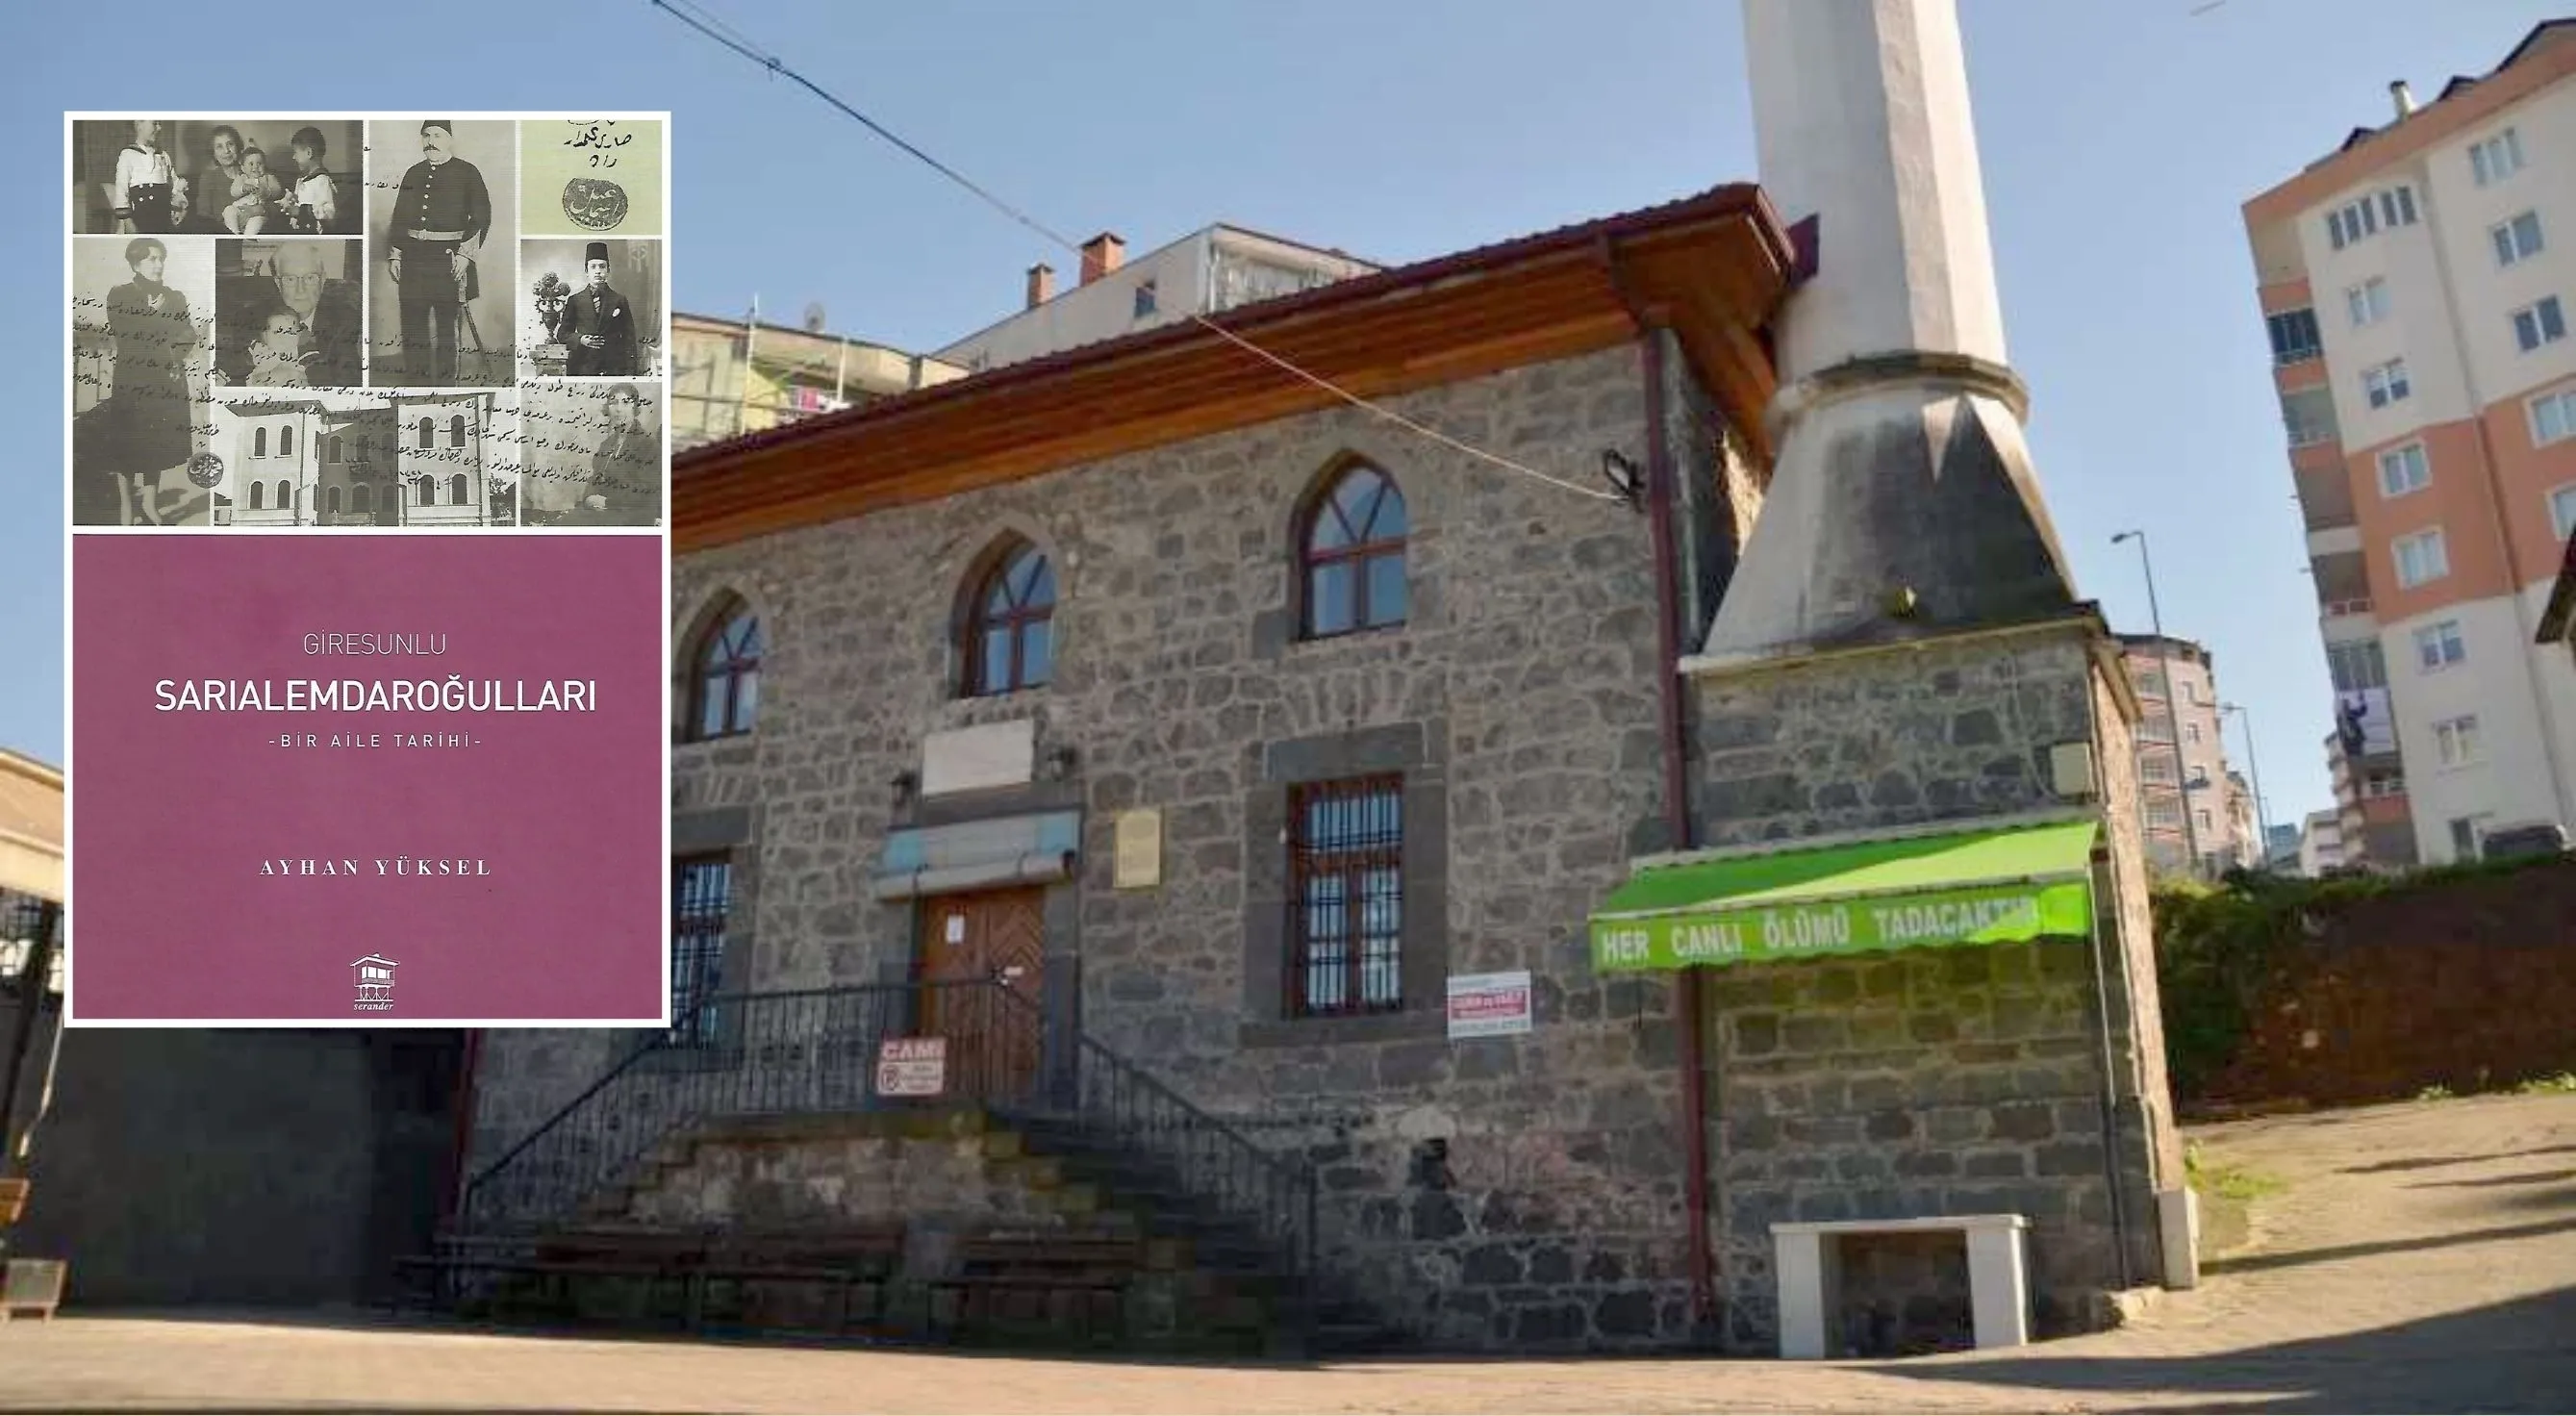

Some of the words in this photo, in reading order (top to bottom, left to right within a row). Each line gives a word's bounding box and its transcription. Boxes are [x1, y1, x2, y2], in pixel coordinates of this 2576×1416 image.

[1601, 928, 1650, 962] HER
[1671, 922, 1742, 958] CANLI
[1763, 905, 1850, 948] ÖLÜMÜ
